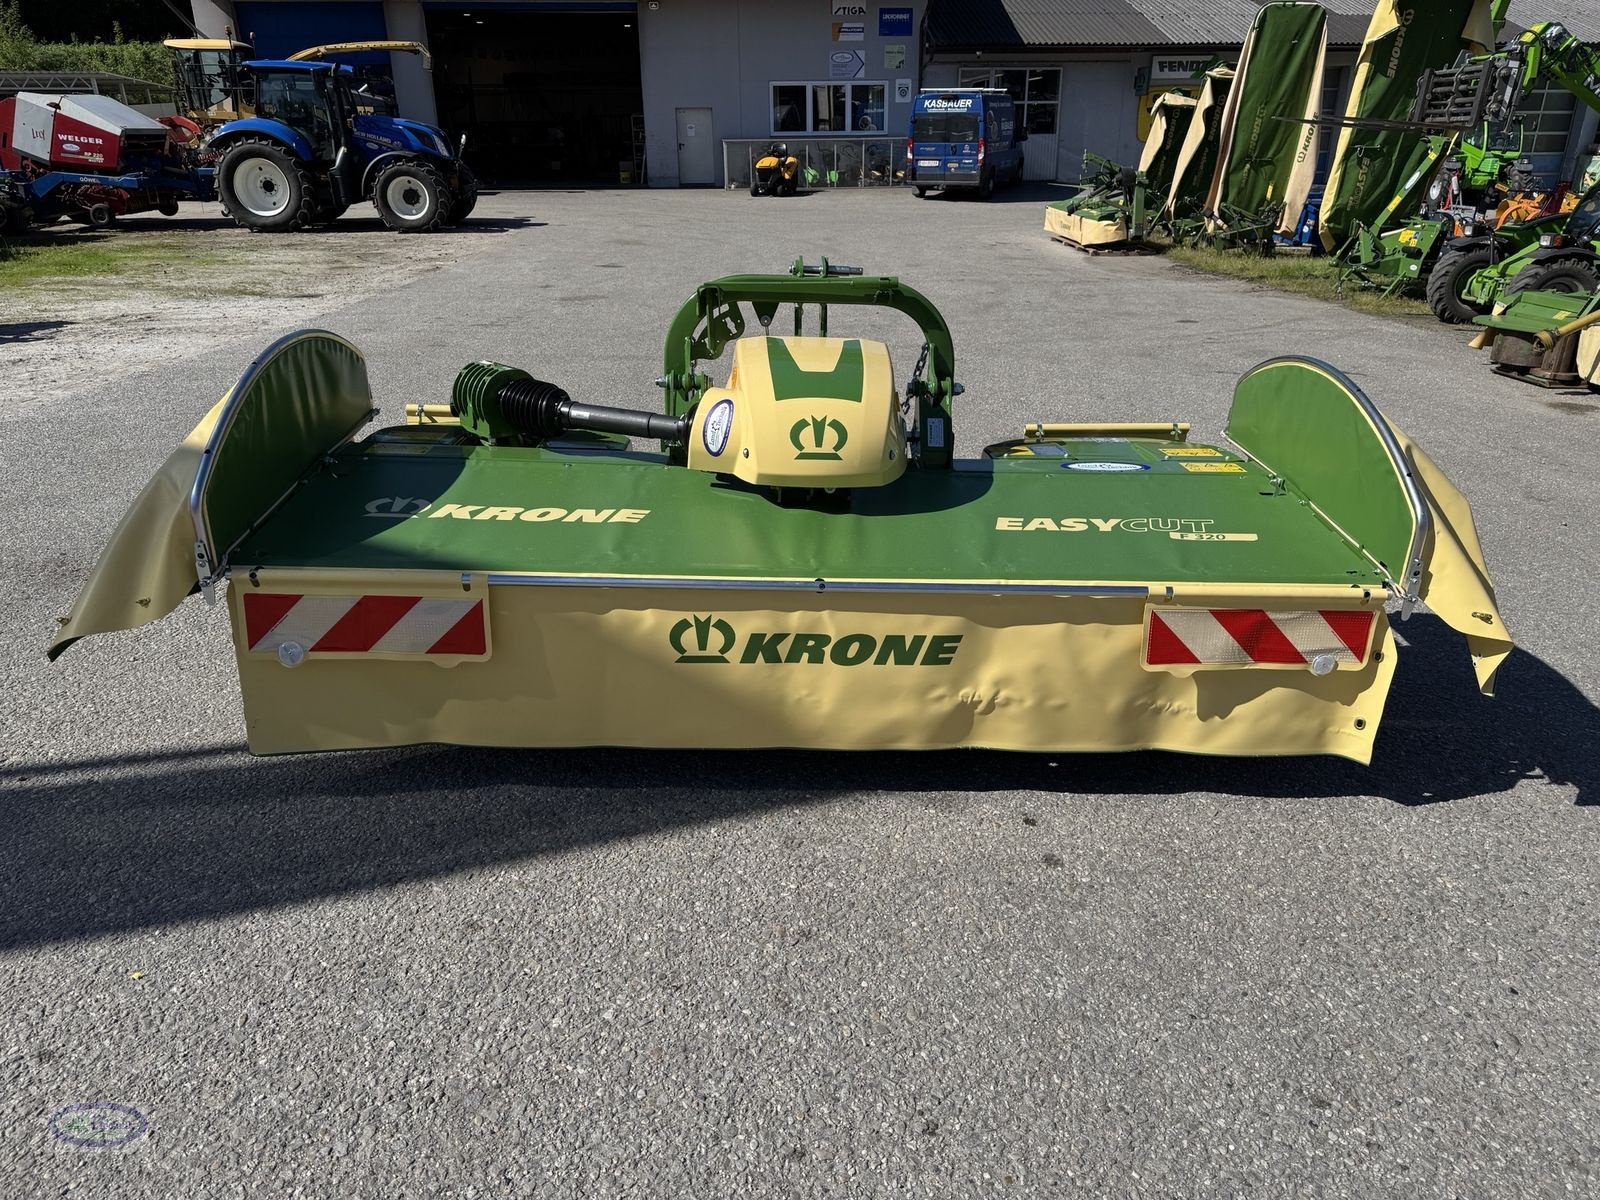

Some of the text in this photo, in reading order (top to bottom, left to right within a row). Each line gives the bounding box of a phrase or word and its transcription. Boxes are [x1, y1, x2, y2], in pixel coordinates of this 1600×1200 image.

[834, 6, 866, 15] STIGA
[1387, 26, 1407, 79] KRONE
[924, 99, 972, 108] KASBAUER
[57, 133, 103, 144] WELGER
[428, 503, 652, 523] KRONE
[995, 516, 1214, 532] EASYCUT
[739, 633, 964, 667] KRONE
